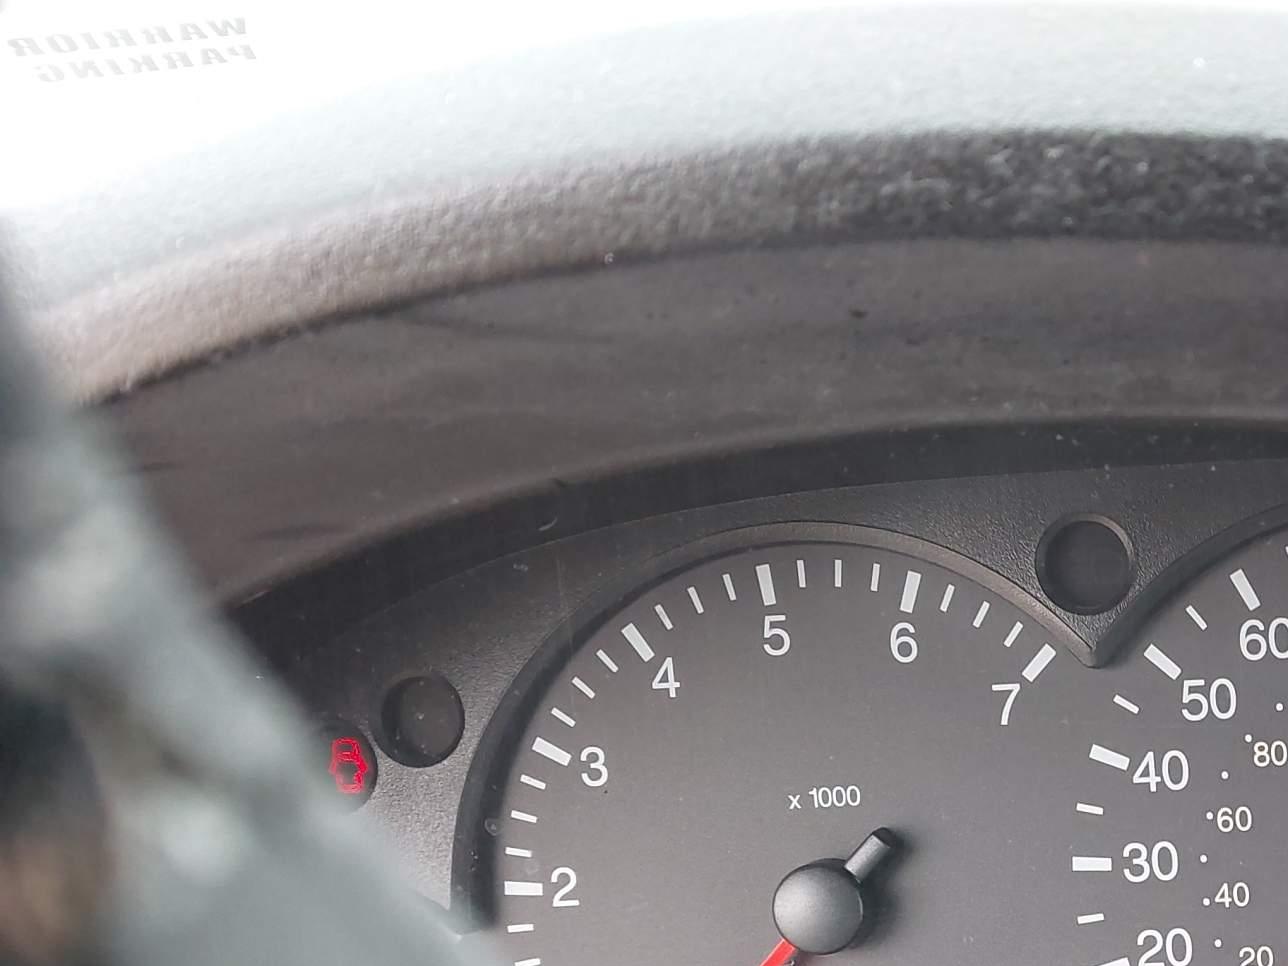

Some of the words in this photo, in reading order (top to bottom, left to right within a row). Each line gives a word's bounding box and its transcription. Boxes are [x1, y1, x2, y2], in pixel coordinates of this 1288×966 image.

[761, 614, 791, 656] 5
[889, 621, 918, 664] 6
[651, 657, 681, 698] 4
[991, 683, 1021, 726] 7
[1181, 678, 1237, 722] 50
[580, 747, 609, 787] 3
[1132, 749, 1189, 792] 40
[1252, 740, 1288, 767] 80
[808, 785, 861, 808] 1000
[1216, 806, 1252, 833] 60
[1122, 840, 1179, 883] 30
[550, 867, 580, 908] 2
[1214, 882, 1250, 908] 40
